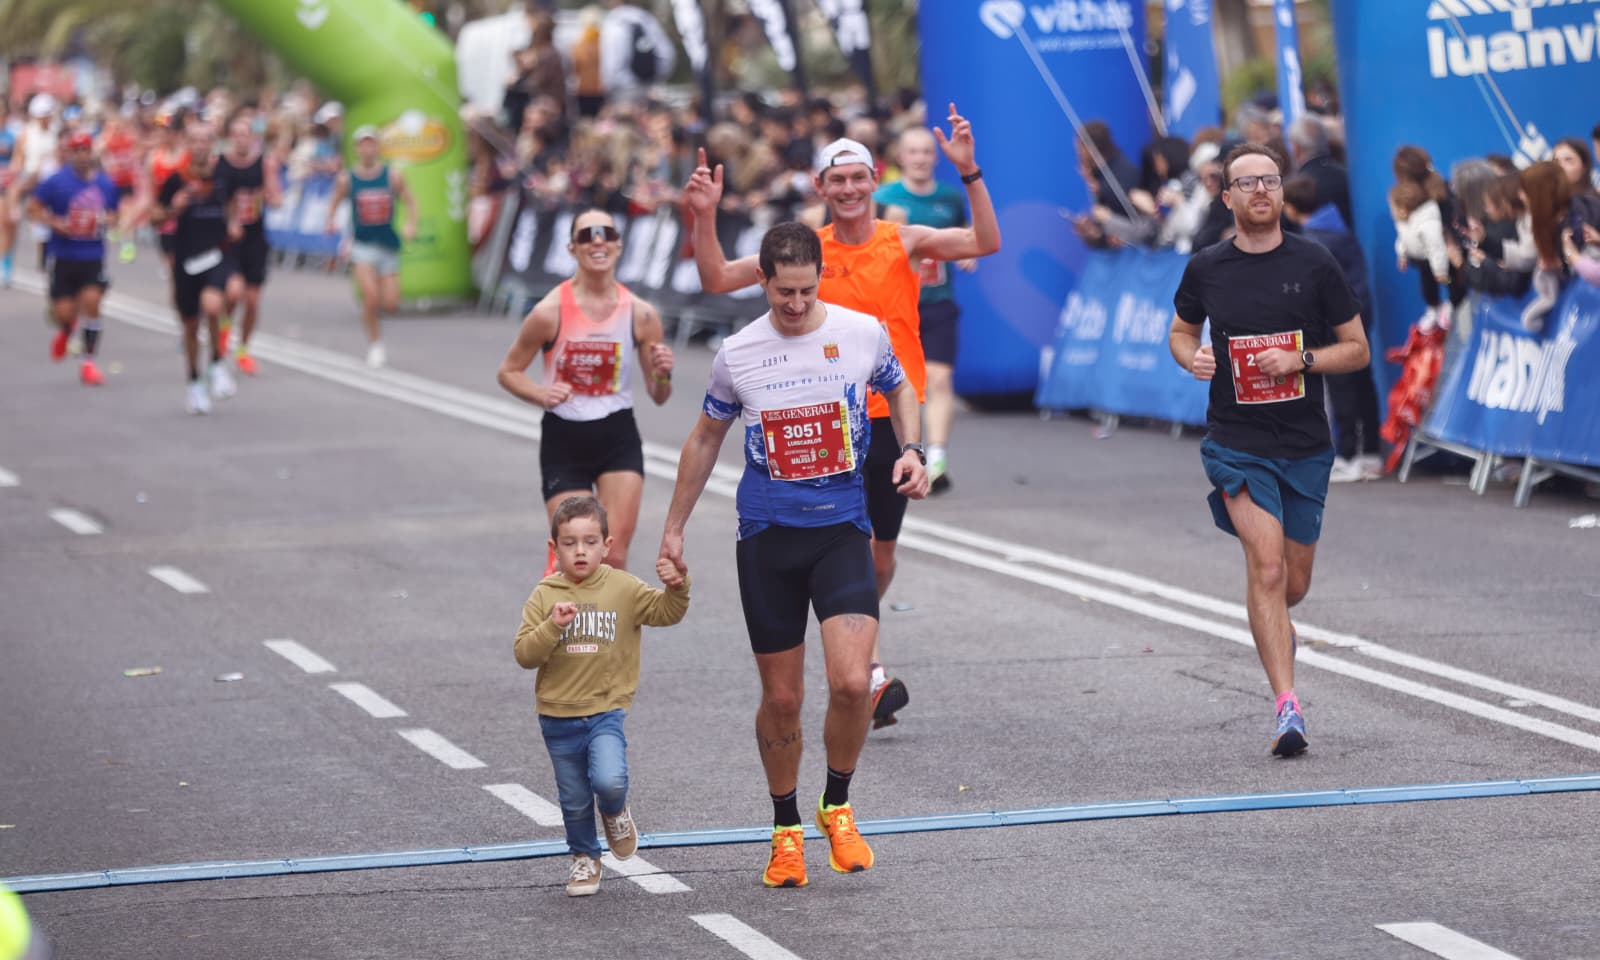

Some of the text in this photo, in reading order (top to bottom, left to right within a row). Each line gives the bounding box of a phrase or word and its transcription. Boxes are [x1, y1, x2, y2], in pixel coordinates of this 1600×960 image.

[1246, 335, 1292, 348] GENERALI
[782, 403, 834, 419] GENERALI
[783, 422, 822, 439] 3051
[560, 611, 617, 642] PPINESS
